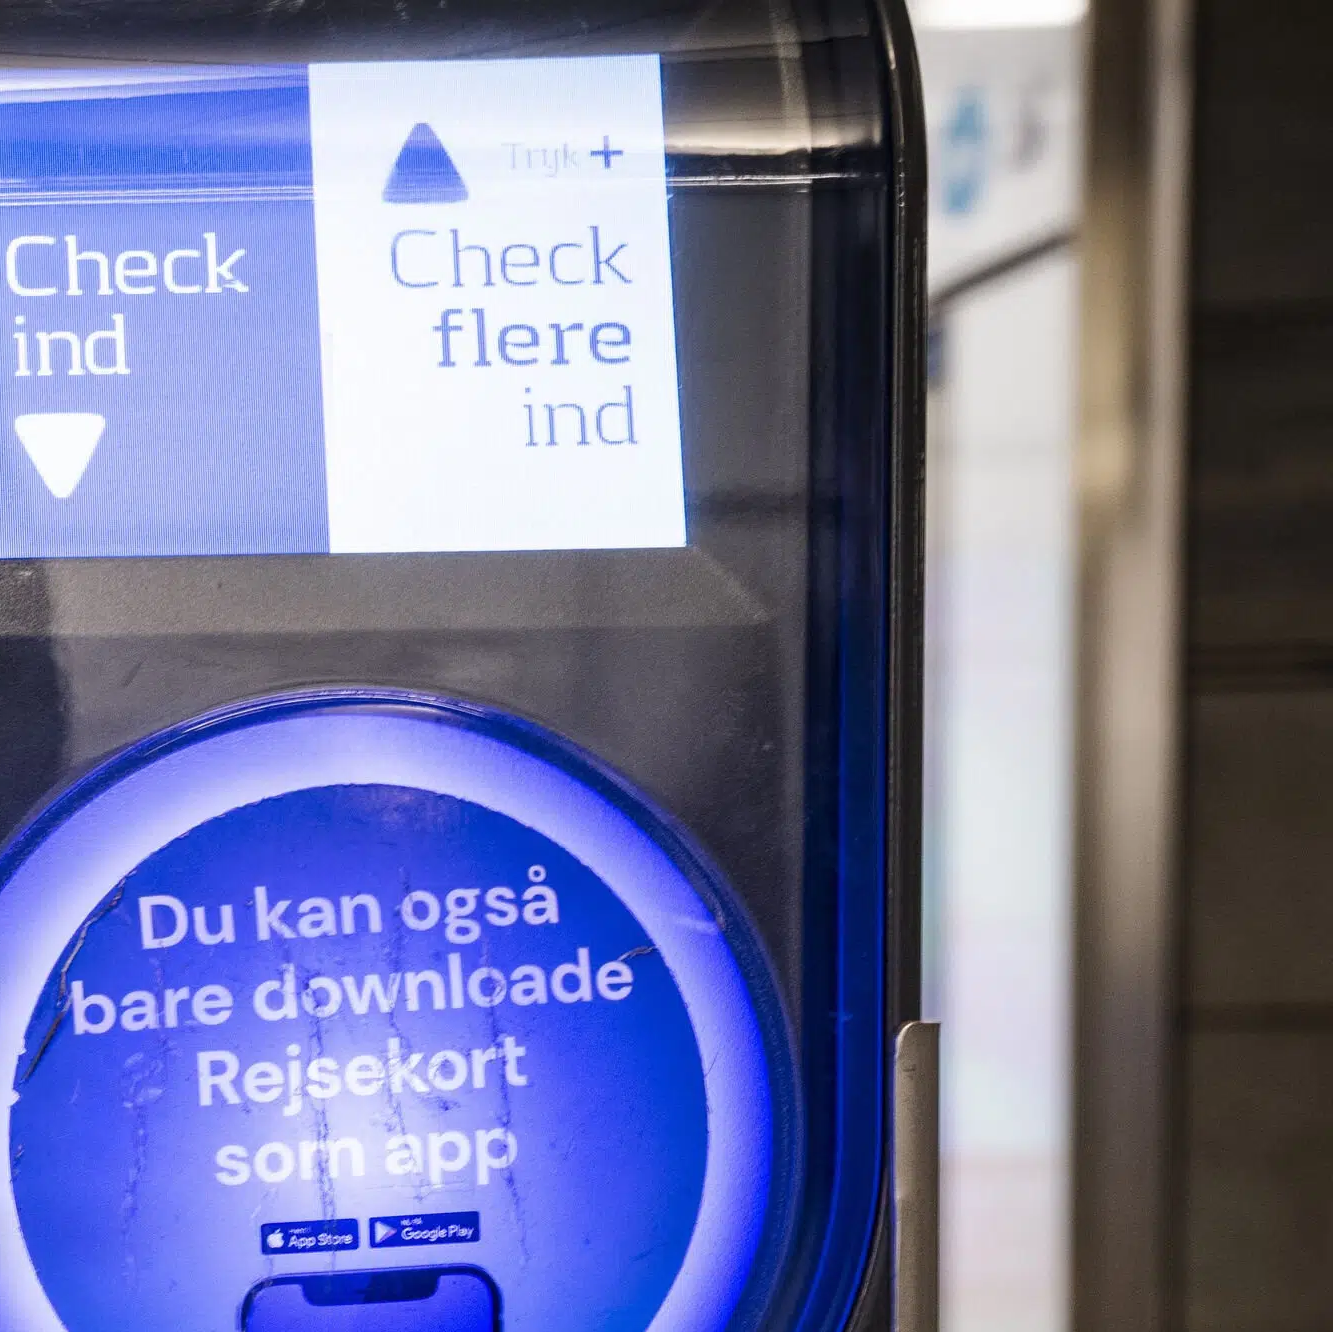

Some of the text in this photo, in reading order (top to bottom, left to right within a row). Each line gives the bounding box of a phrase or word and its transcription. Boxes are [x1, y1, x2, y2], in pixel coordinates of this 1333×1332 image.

[5, 232, 249, 297] Check
[390, 225, 632, 289] Check
[13, 313, 131, 377] ind
[432, 307, 632, 368] flere
[523, 384, 637, 447] ind
[138, 865, 560, 950] Du kan også
[67, 947, 634, 1036] bare downloade
[197, 1035, 528, 1117] Rejsekort
[214, 1126, 519, 1186] som app
[288, 1232, 354, 1249] App Store
[401, 1223, 474, 1242] Google Play
